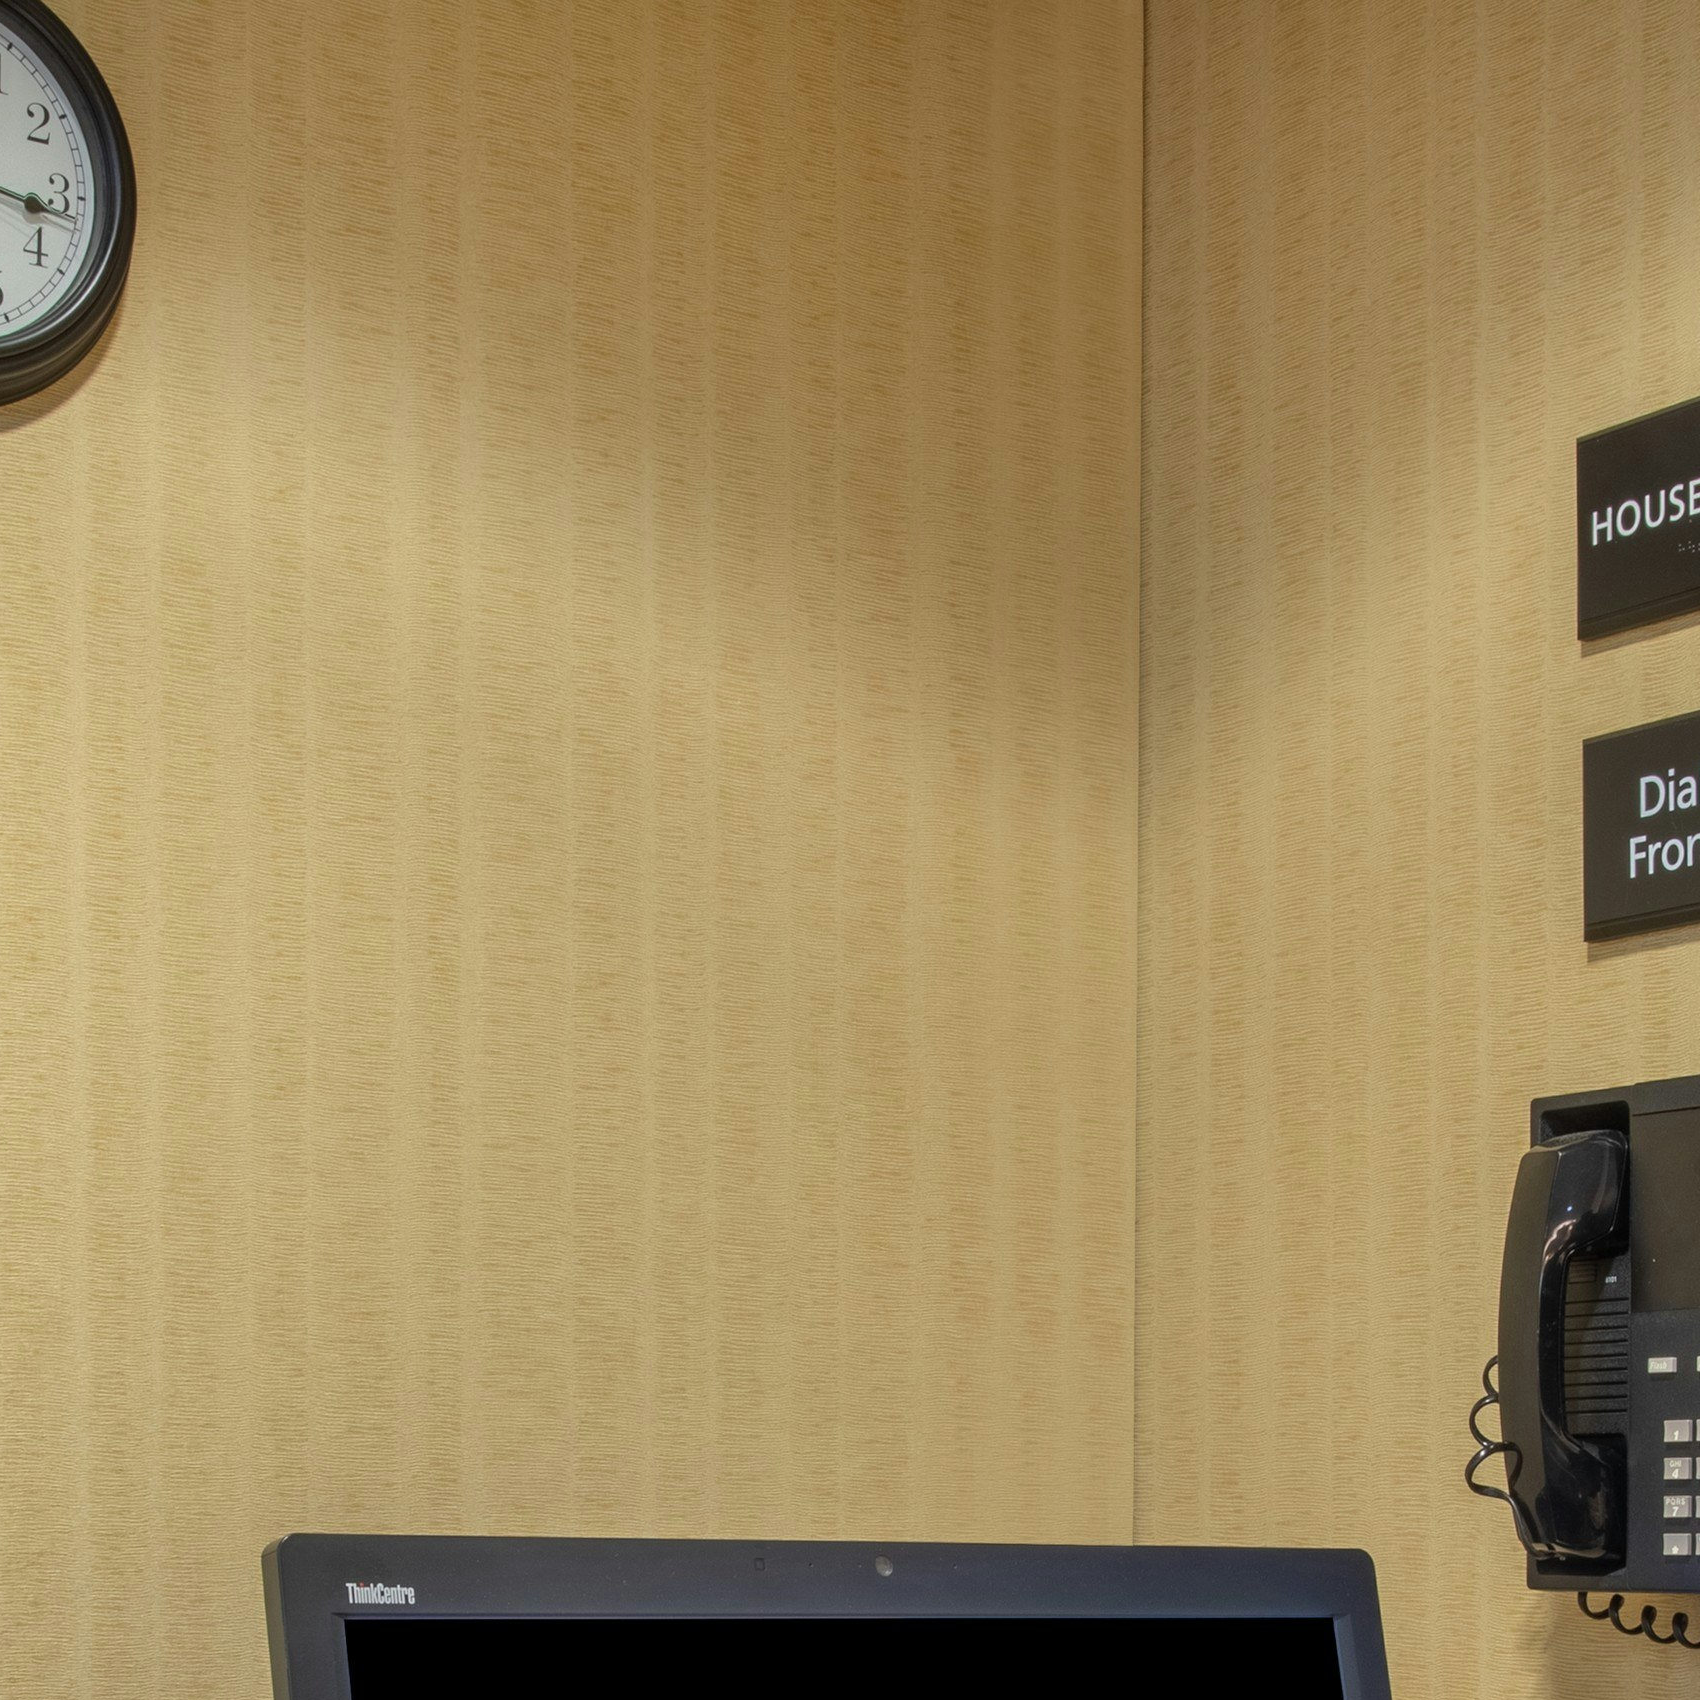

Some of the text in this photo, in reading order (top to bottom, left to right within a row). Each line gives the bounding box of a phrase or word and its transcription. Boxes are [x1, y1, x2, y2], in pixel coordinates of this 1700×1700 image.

[26, 103, 51, 145] 2
[47, 173, 70, 215] 3
[23, 227, 48, 268] 4
[1650, 1361, 1667, 1370] Flash
[1673, 1430, 1679, 1440] 1
[1669, 1460, 1682, 1468] GHI
[1671, 1468, 1679, 1479] 4
[1672, 1506, 1679, 1517] 7
[346, 1582, 415, 1605] ThinkCentre
